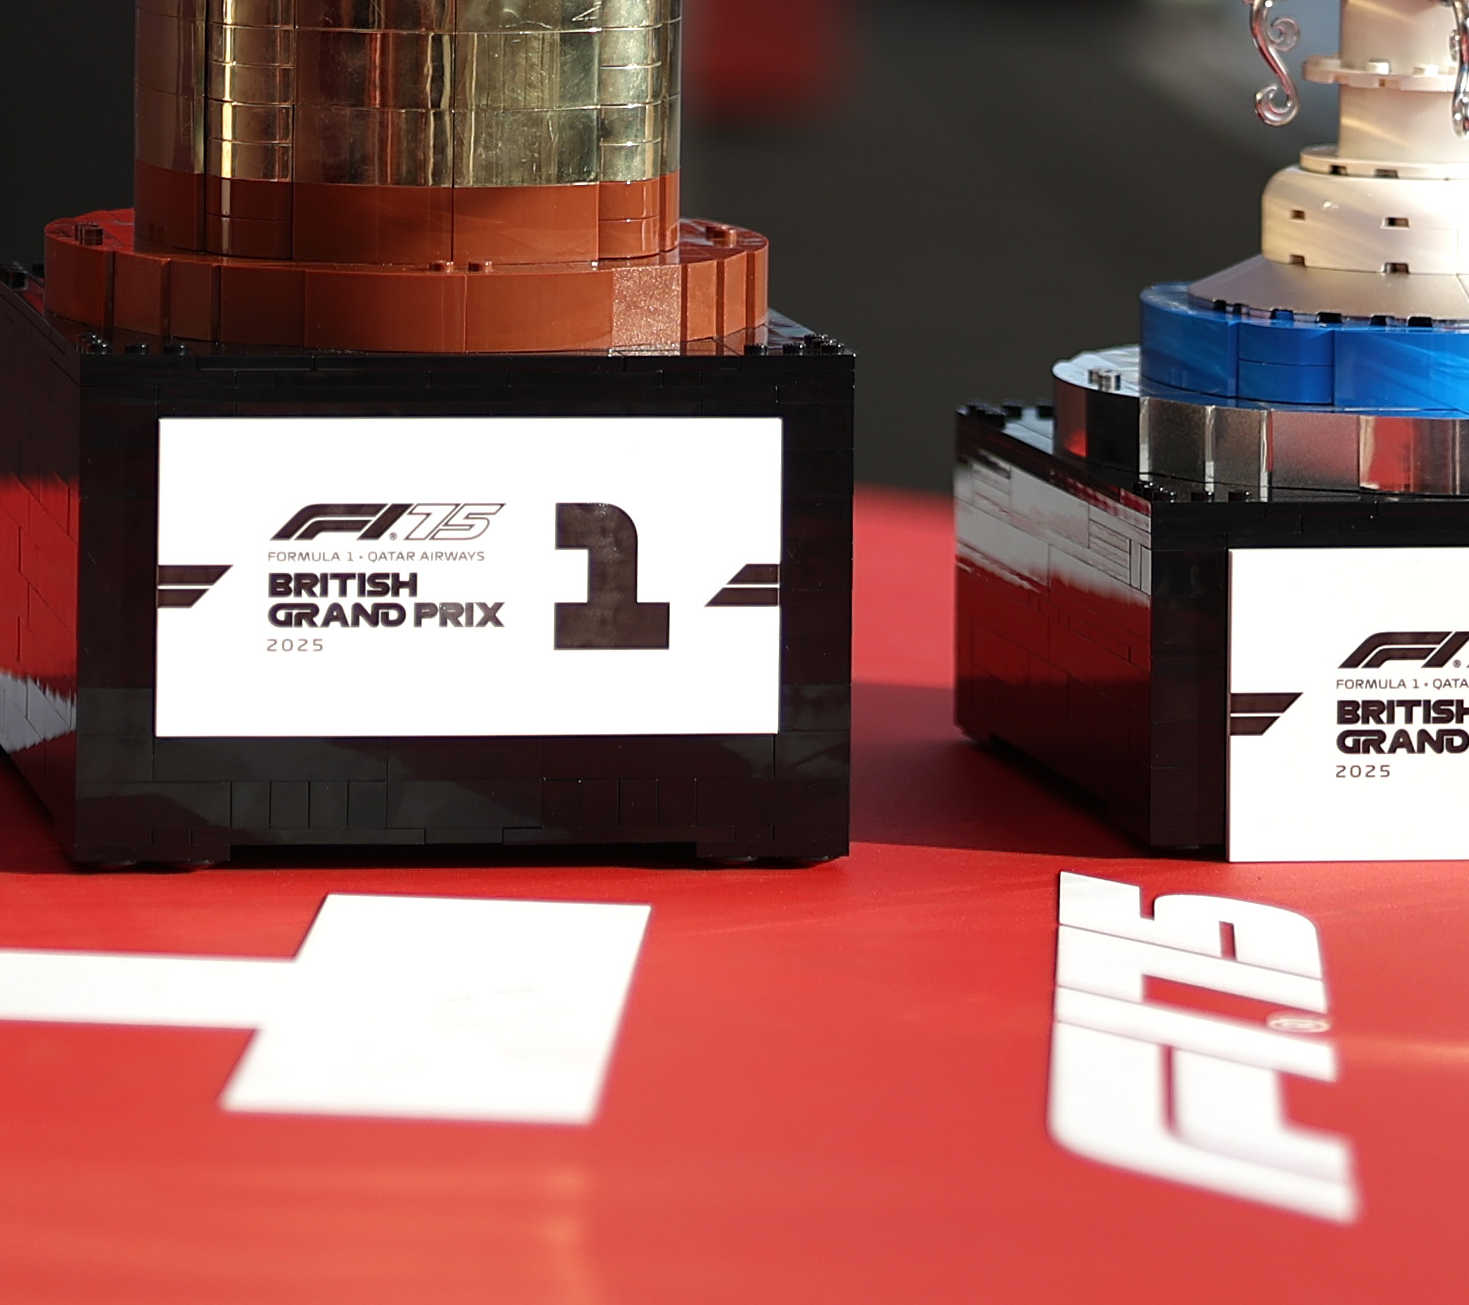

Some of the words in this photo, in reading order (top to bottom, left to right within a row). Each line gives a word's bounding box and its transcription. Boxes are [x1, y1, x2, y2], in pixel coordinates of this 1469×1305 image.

[268, 552, 340, 561] FORMULA
[348, 552, 353, 561] 1
[368, 552, 415, 563] QATAR
[420, 552, 484, 561] AIRWAYS
[268, 572, 417, 597] BRITISH
[554, 502, 670, 650] 1
[268, 602, 406, 628] GRAND
[414, 602, 505, 627] PRIX
[267, 639, 323, 651] 2025
[1336, 679, 1406, 689] FORMULA
[1413, 679, 1419, 689] 1
[1336, 729, 1469, 754] GRAND
[1336, 765, 1390, 778] 2025
